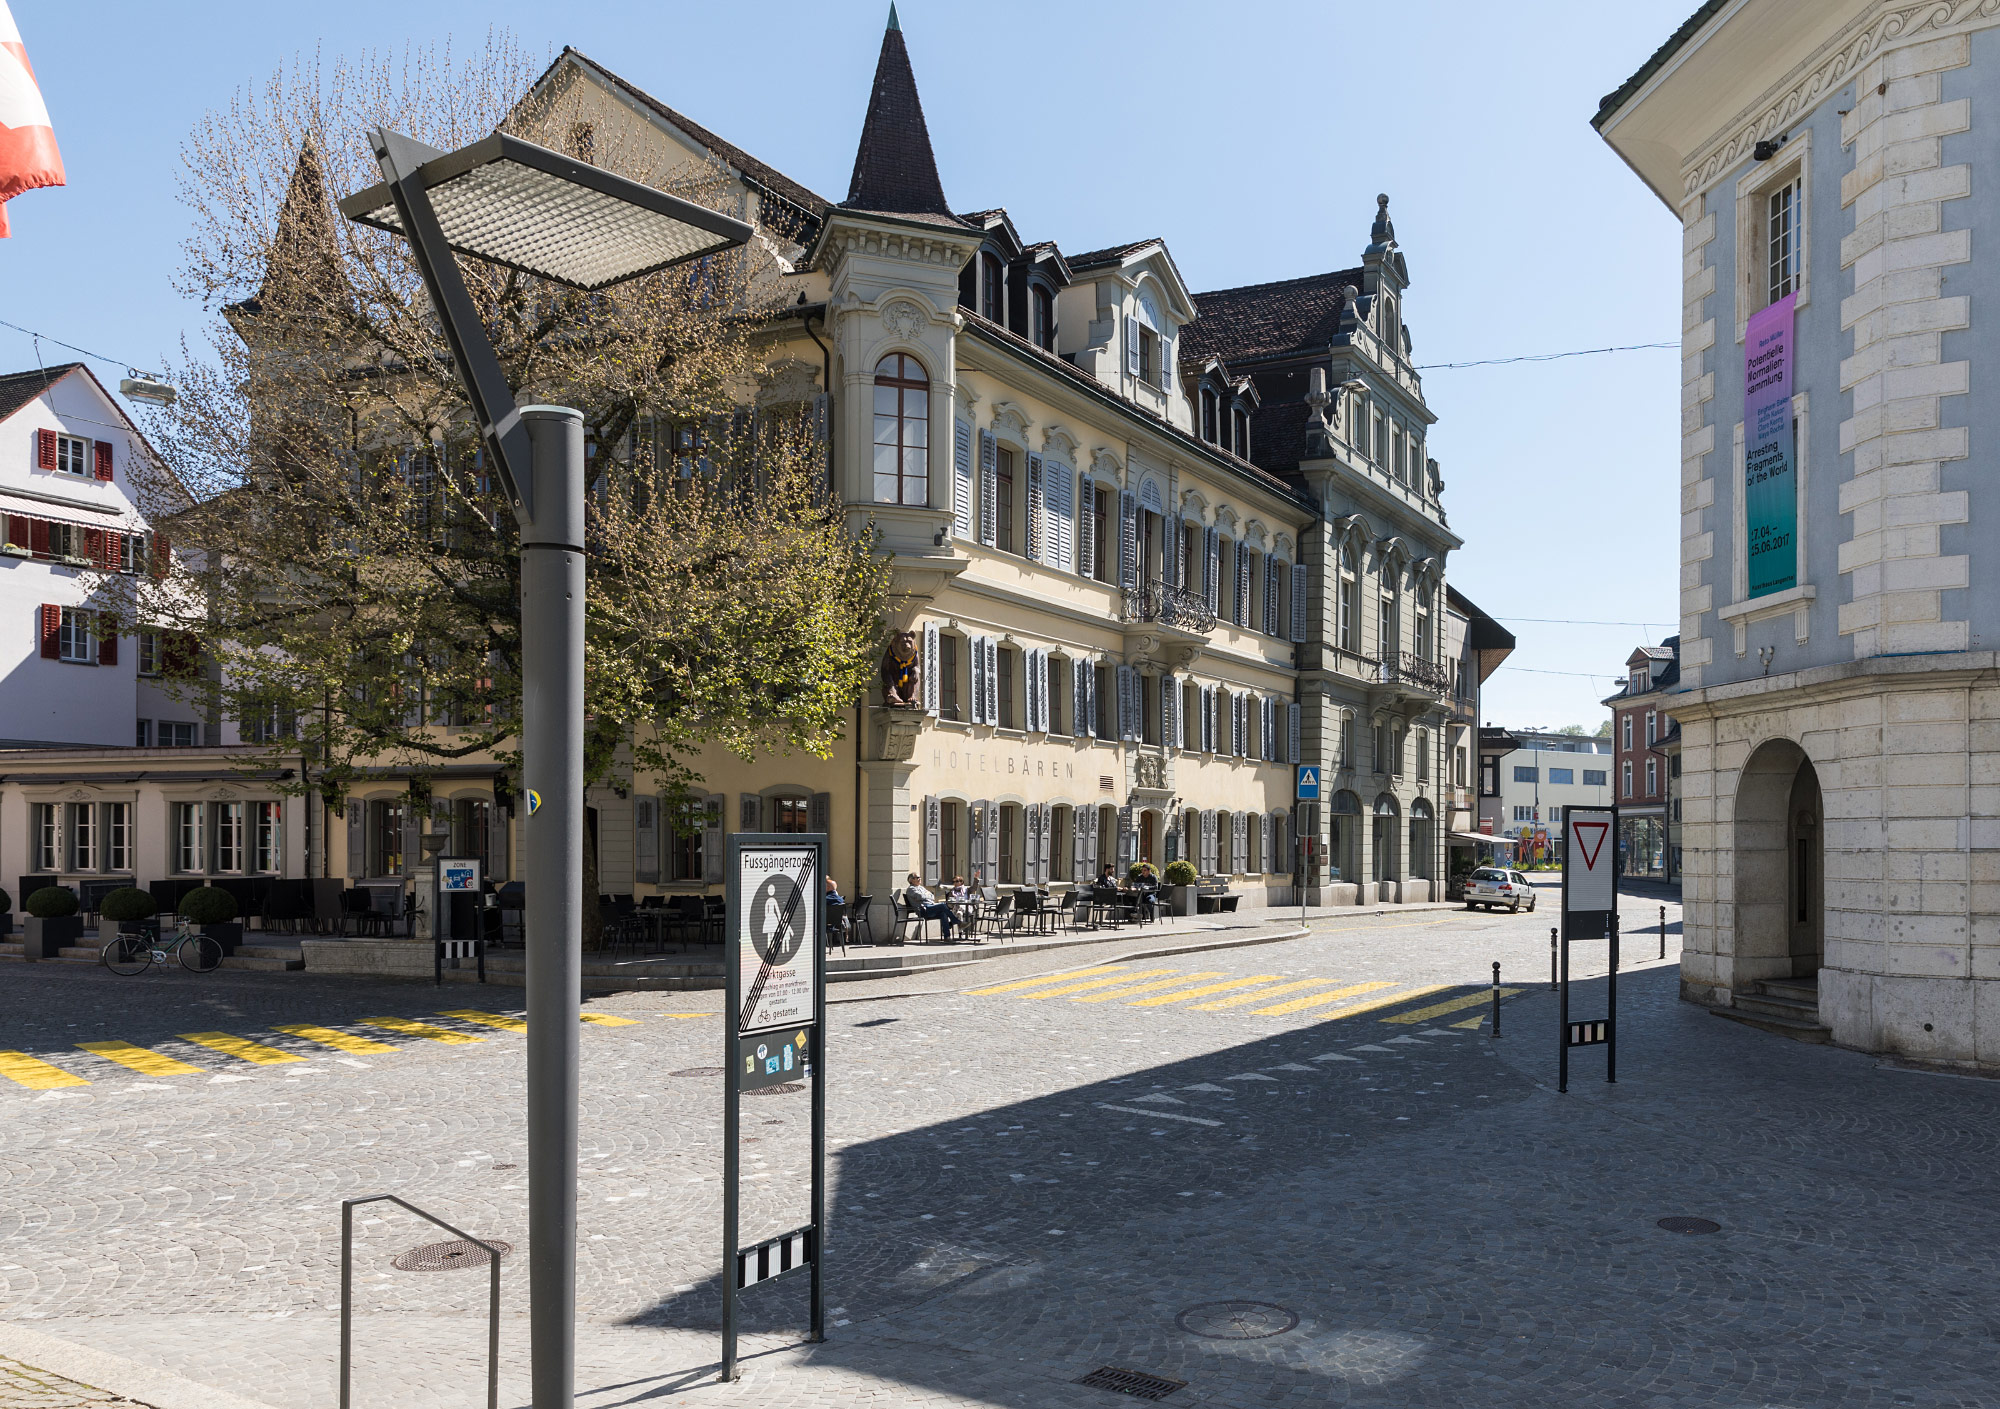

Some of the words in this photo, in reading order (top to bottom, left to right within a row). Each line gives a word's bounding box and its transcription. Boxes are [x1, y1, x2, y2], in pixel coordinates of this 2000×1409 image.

[1747, 344, 1784, 370] Potentielle
[1747, 359, 1785, 383] Normalien-
[1747, 371, 1783, 395] sammlung
[1746, 441, 1778, 461] Arresting
[1746, 451, 1784, 474] Fragments
[1747, 473, 1755, 487] of
[1756, 470, 1767, 484] the
[1769, 461, 1788, 477] World
[933, 749, 1000, 772] HOTEL
[1007, 755, 1074, 779] BÄREN
[772, 1007, 799, 1020] gestattet
